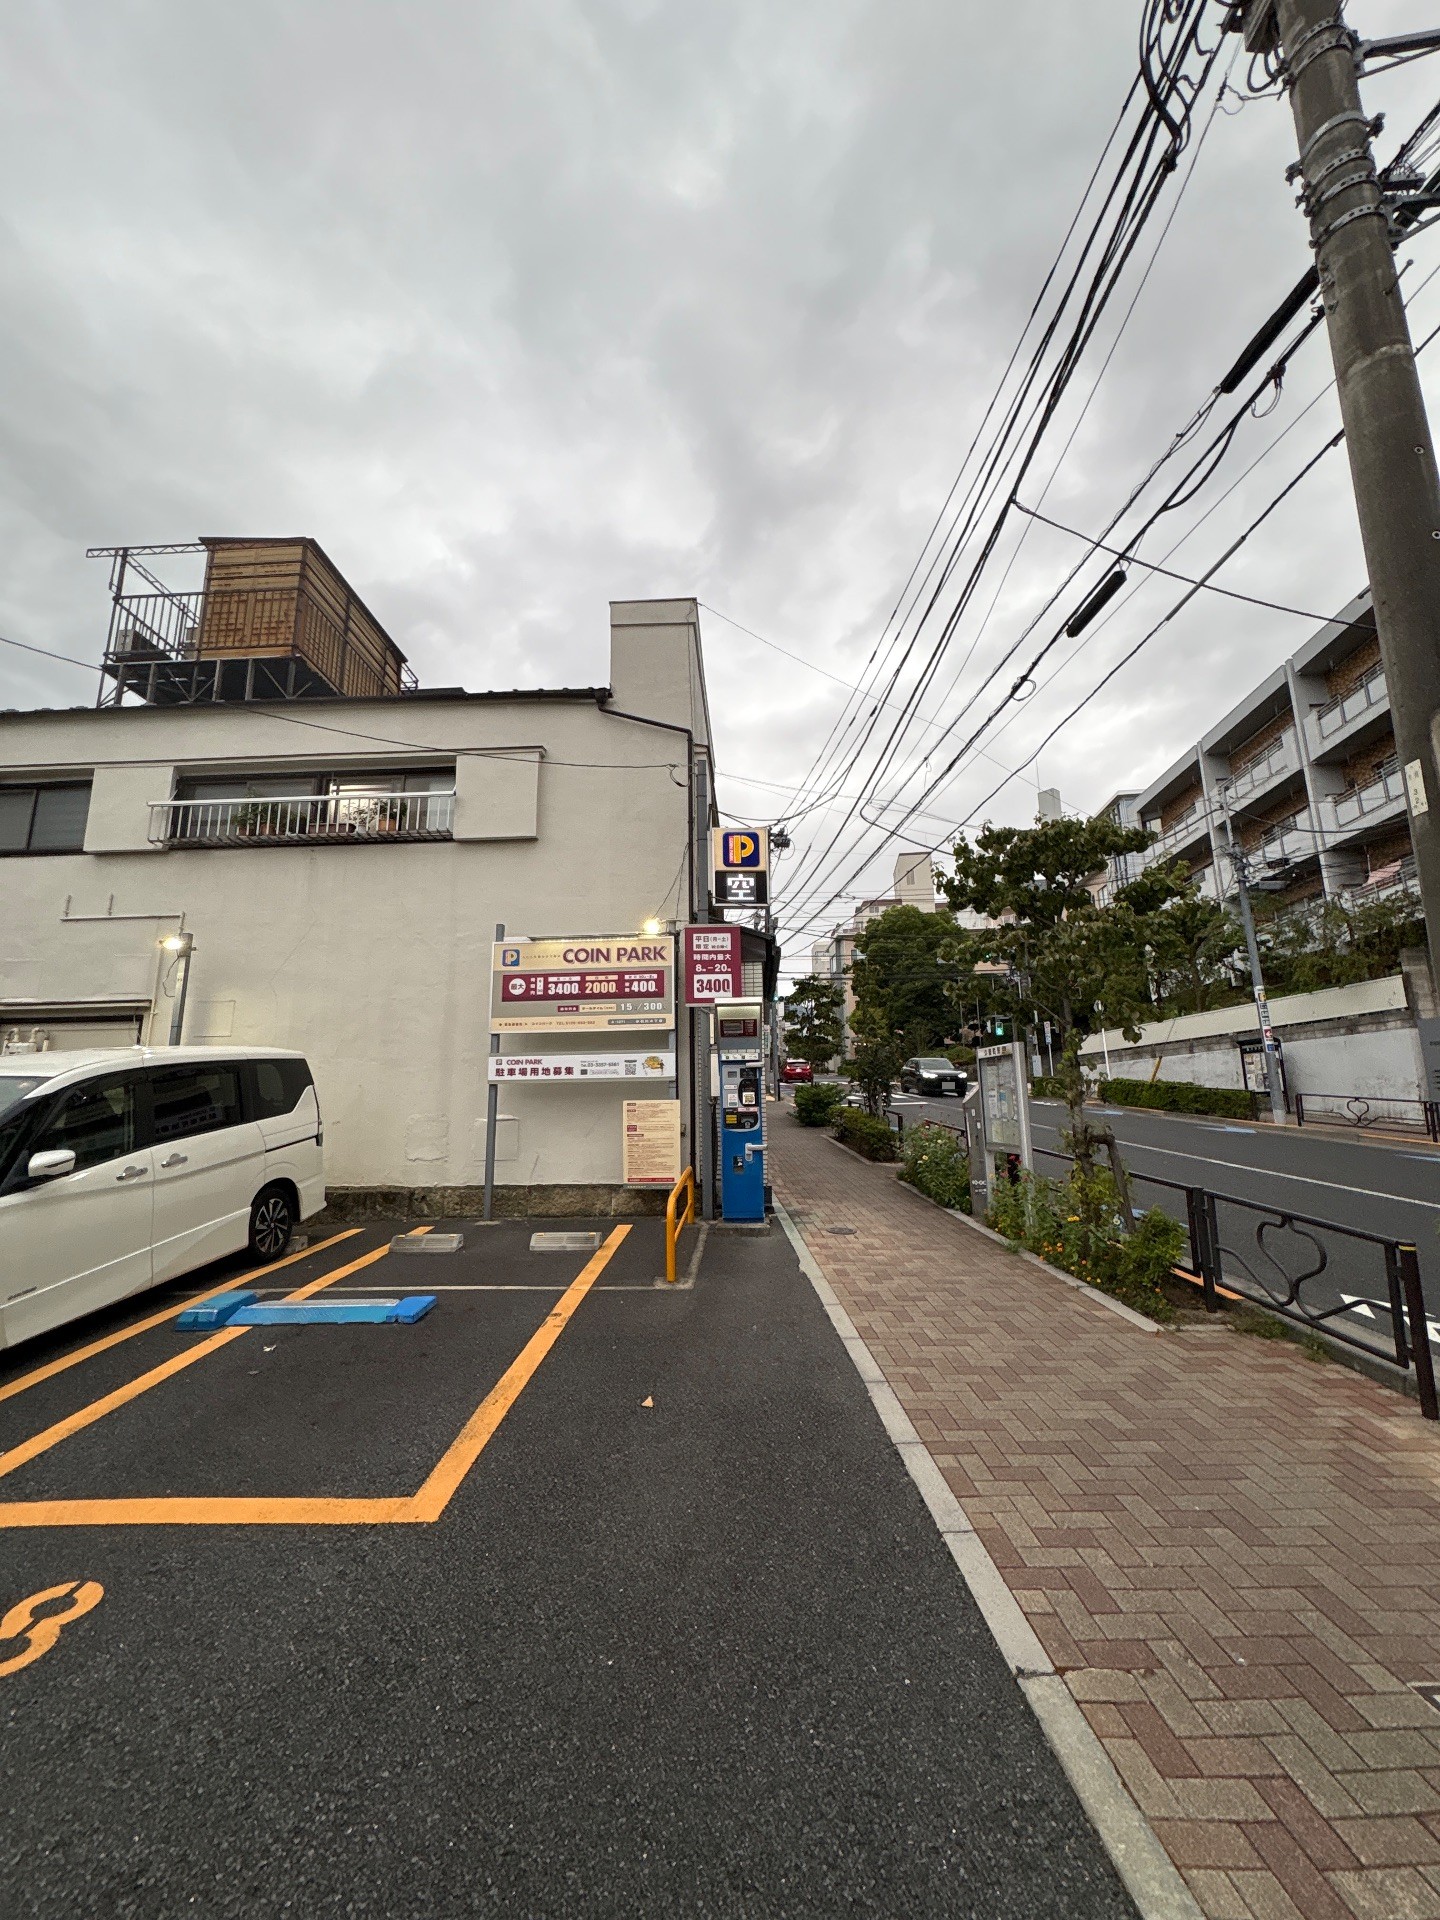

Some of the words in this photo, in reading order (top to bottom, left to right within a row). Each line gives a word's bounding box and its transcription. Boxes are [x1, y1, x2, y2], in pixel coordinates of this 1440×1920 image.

[727, 873, 755, 900] 空
[563, 947, 611, 964] COIN
[616, 946, 668, 962] PARK
[693, 953, 732, 961] 時間内最大
[495, 1067, 574, 1077] 駐車場用地募集
